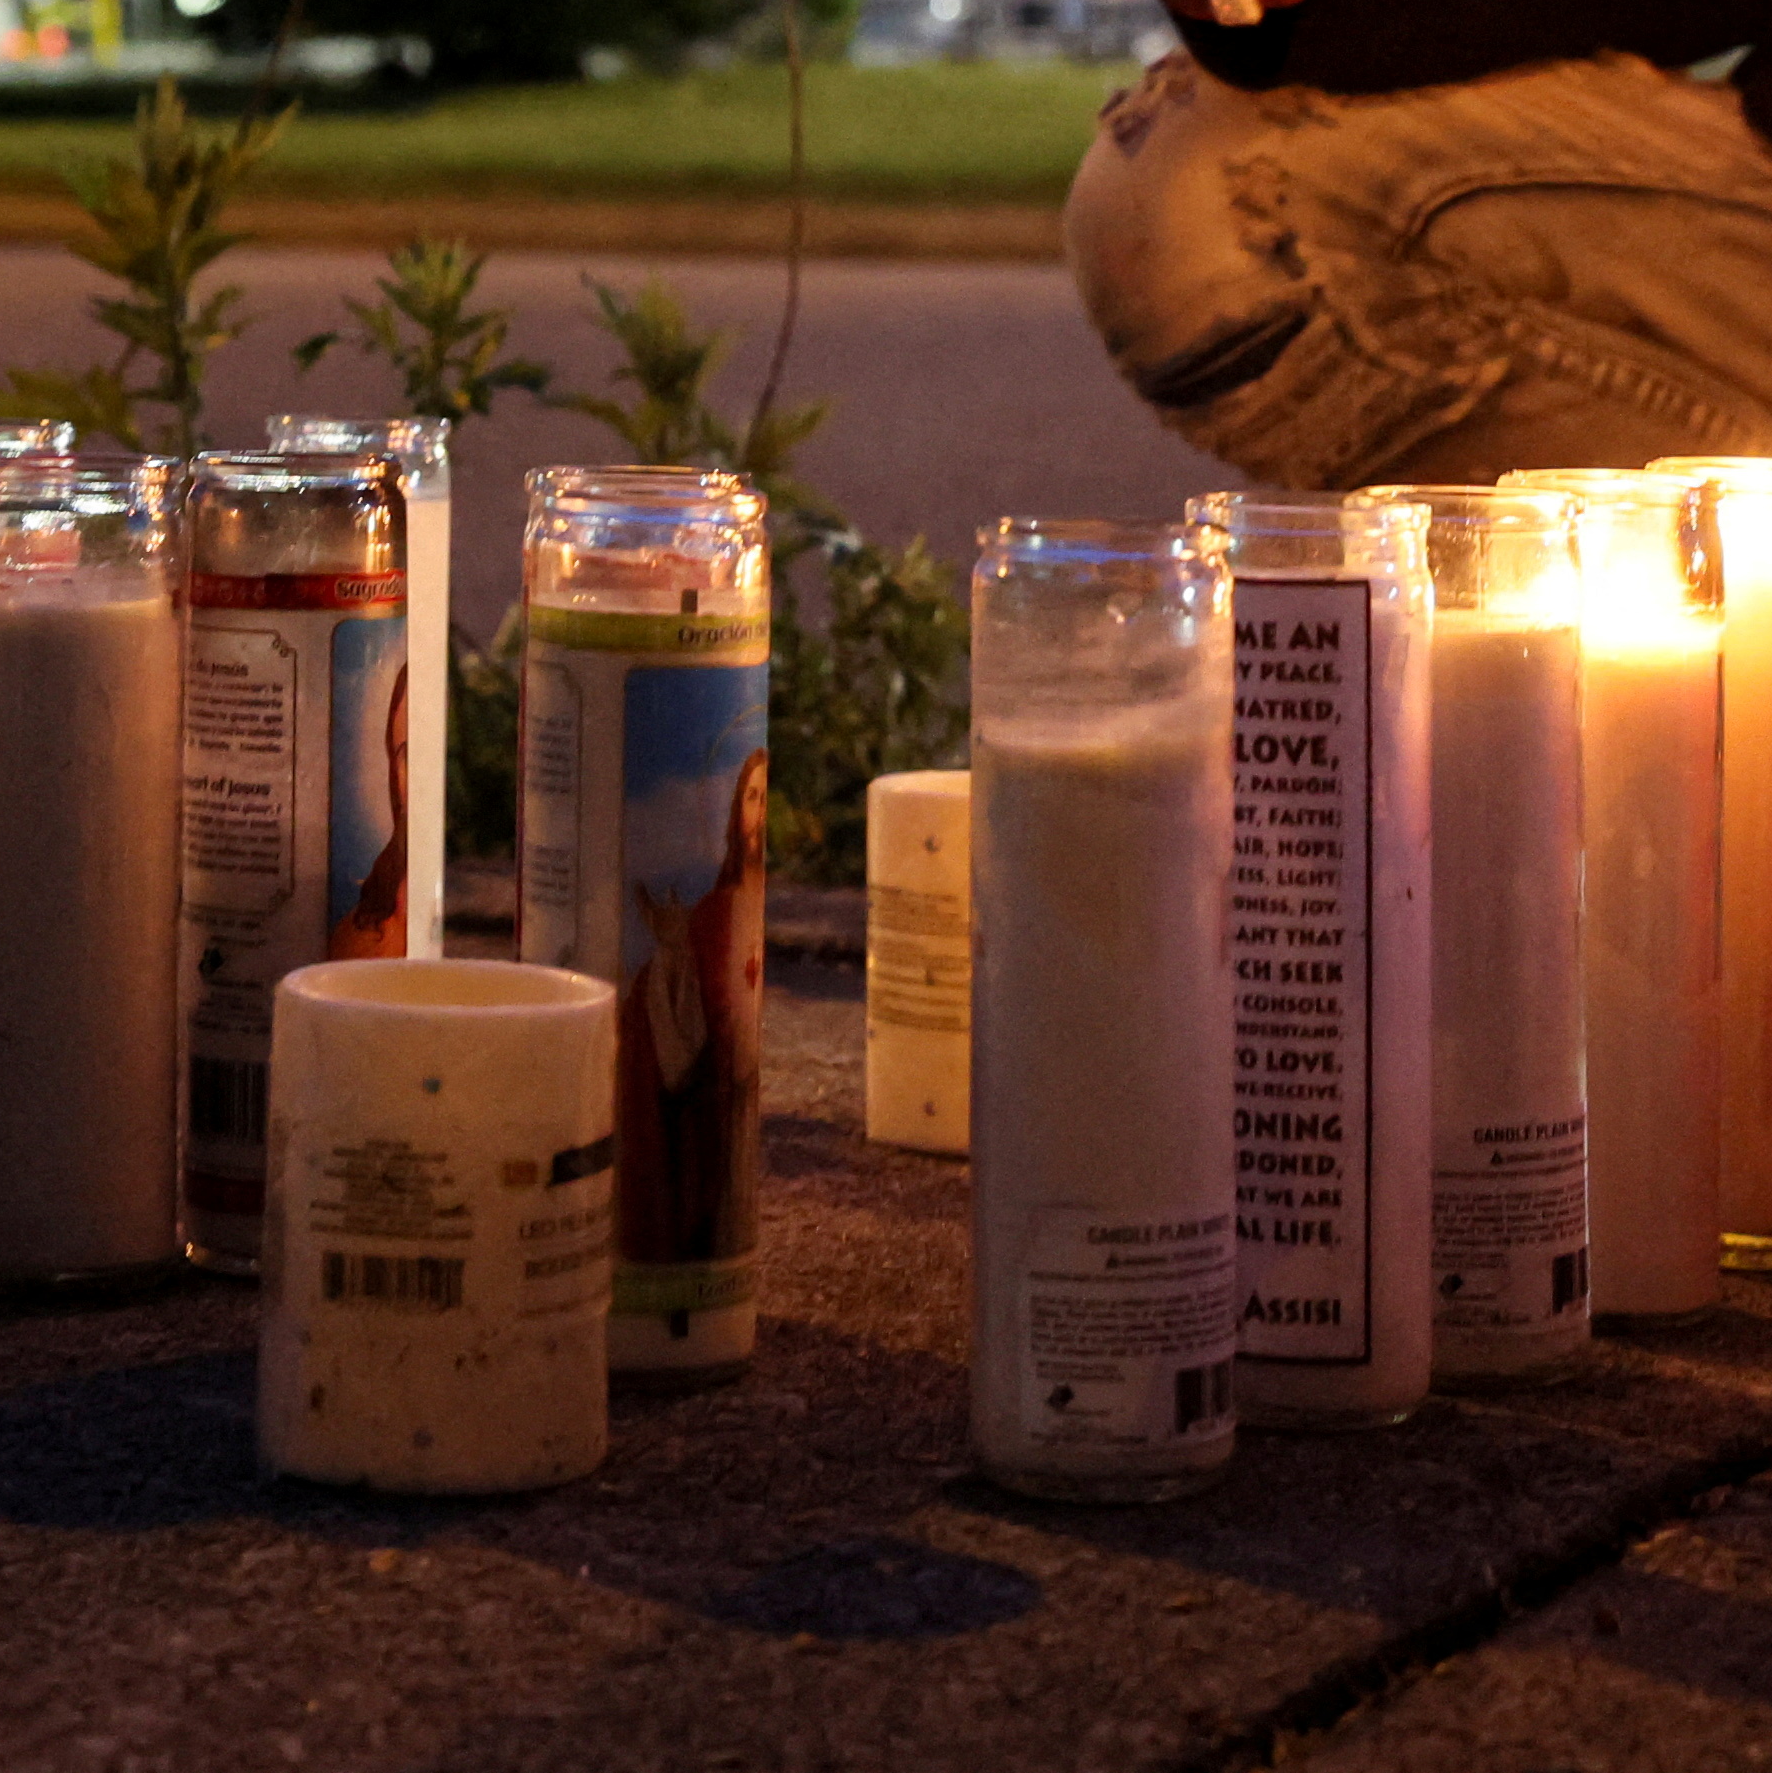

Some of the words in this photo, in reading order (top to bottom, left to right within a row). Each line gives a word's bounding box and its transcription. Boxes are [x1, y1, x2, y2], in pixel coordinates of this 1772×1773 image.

[1289, 621, 1340, 650] AN
[1235, 733, 1340, 769] LOVE,
[1286, 928, 1345, 947] THAT
[1280, 960, 1344, 984] SEEK
[1235, 1109, 1342, 1142] ONING
[1473, 1124, 1532, 1144] CANDLE
[1264, 1189, 1293, 1207] WE
[1300, 1190, 1342, 1208] ARE
[1274, 1218, 1342, 1246] LIFE.
